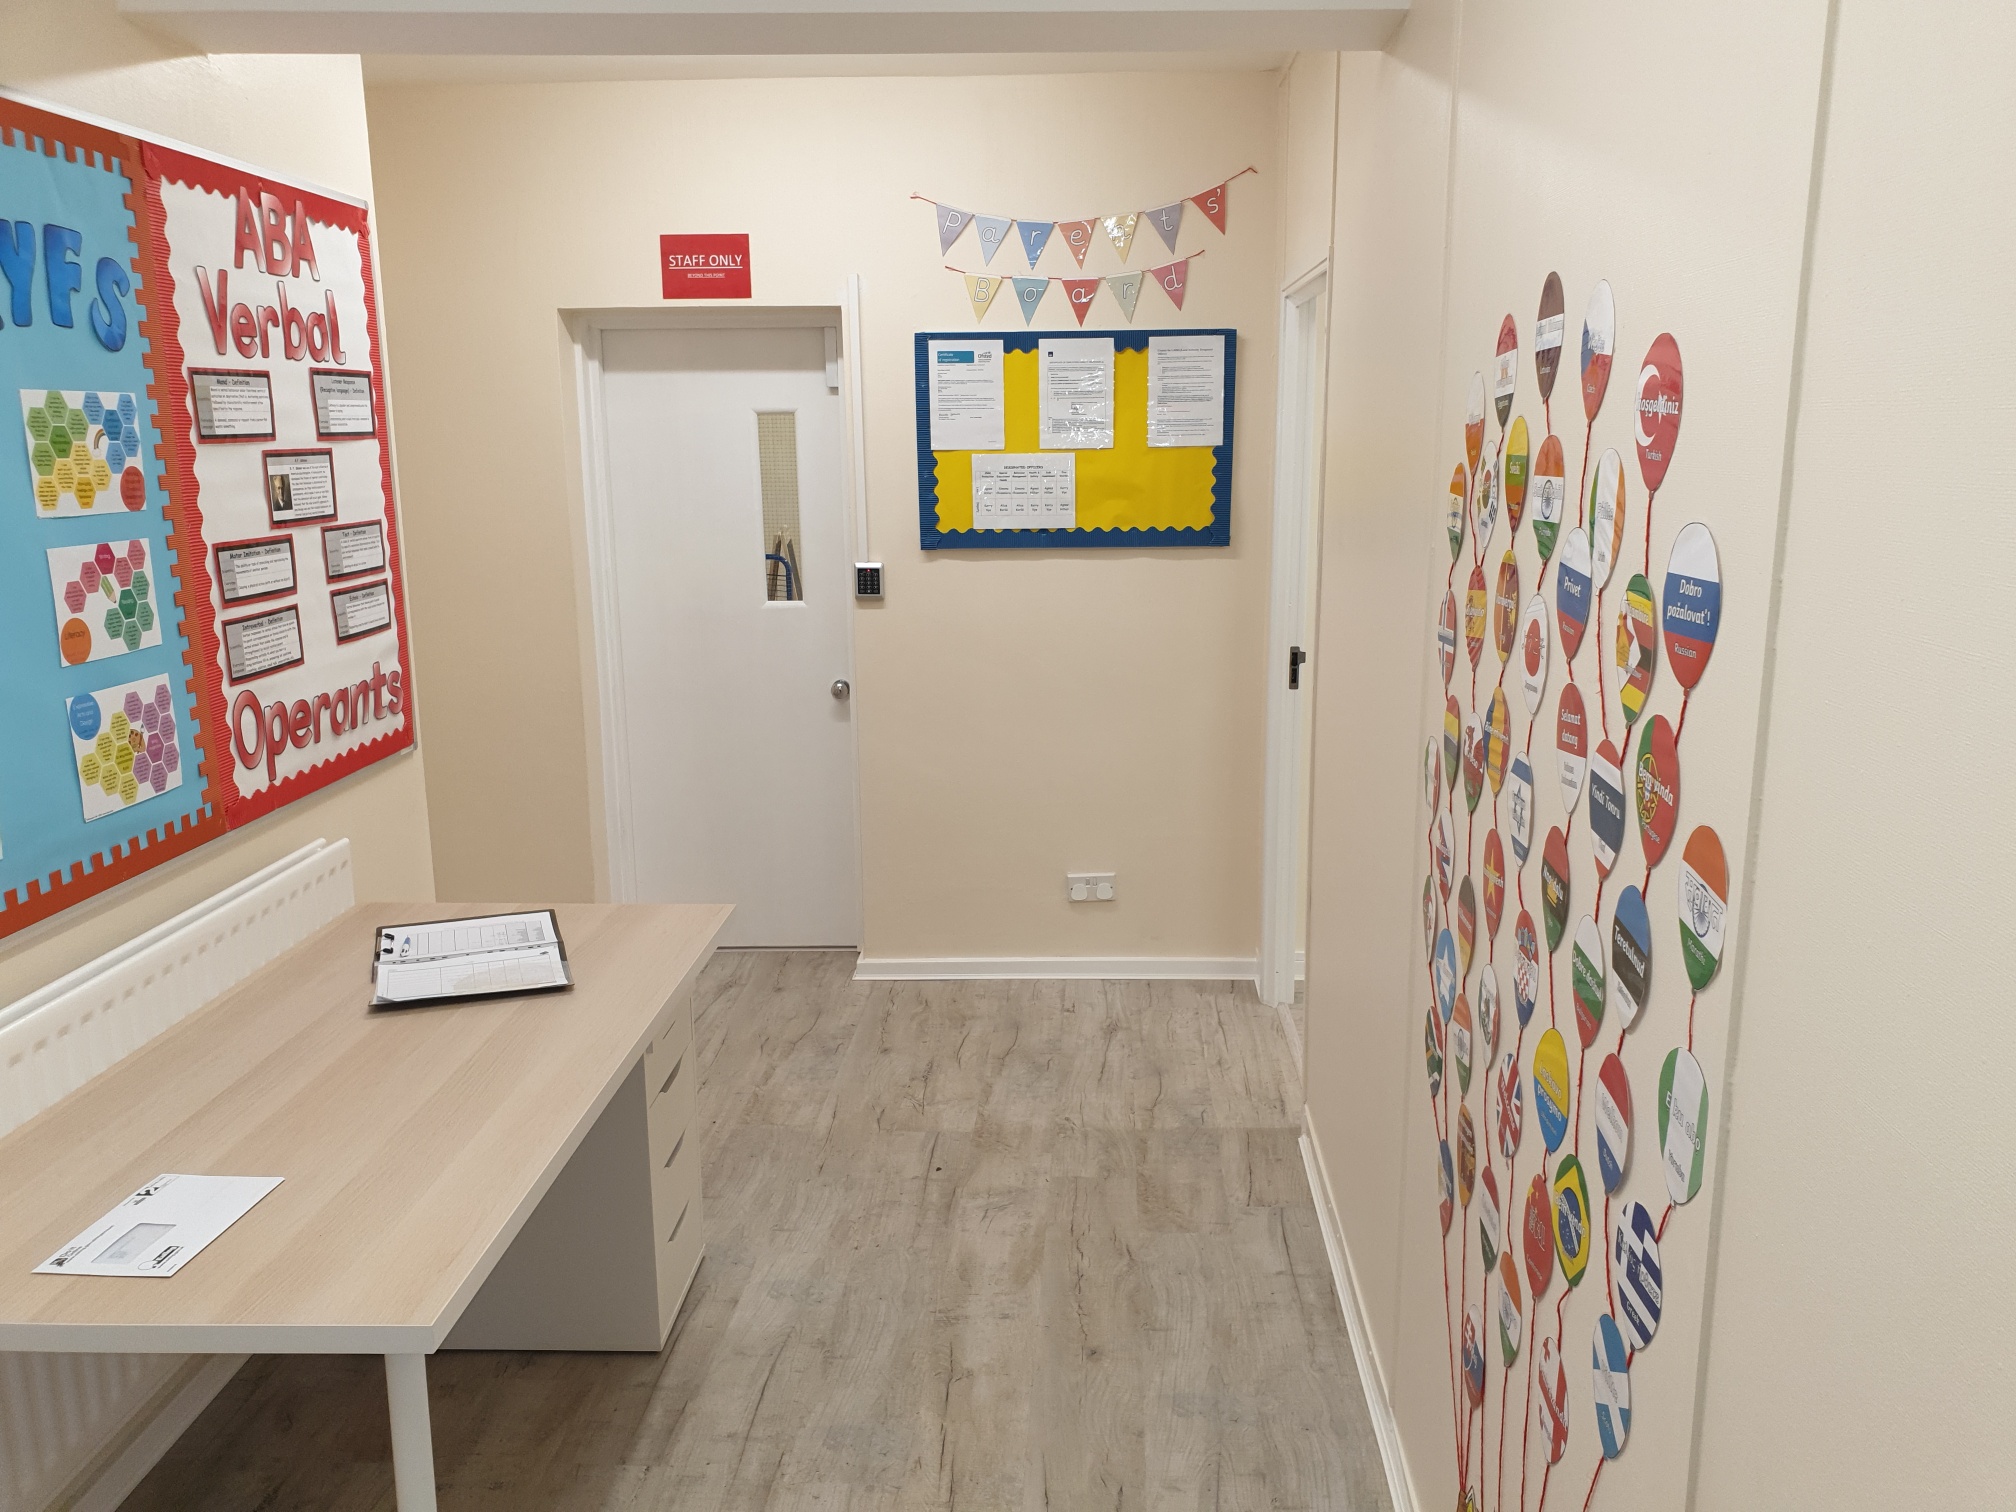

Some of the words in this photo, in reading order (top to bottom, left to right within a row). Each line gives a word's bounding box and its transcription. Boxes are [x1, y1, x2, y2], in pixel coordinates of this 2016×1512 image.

[942, 188, 1222, 246] Parents'
[234, 186, 320, 281] ABA
[668, 255, 705, 267] STAFF
[709, 254, 742, 266] ONLY
[0, 219, 130, 352] YFS
[973, 265, 1183, 303] Board
[196, 265, 346, 365] Verbal
[1564, 576, 1581, 597] Privet
[1679, 578, 1702, 598] Dobro
[1674, 642, 1697, 659] Russian
[233, 661, 403, 782] Operants
[1561, 709, 1580, 725] Selamat
[1562, 729, 1578, 749] datang
[1626, 1300, 1640, 1326] Greek
